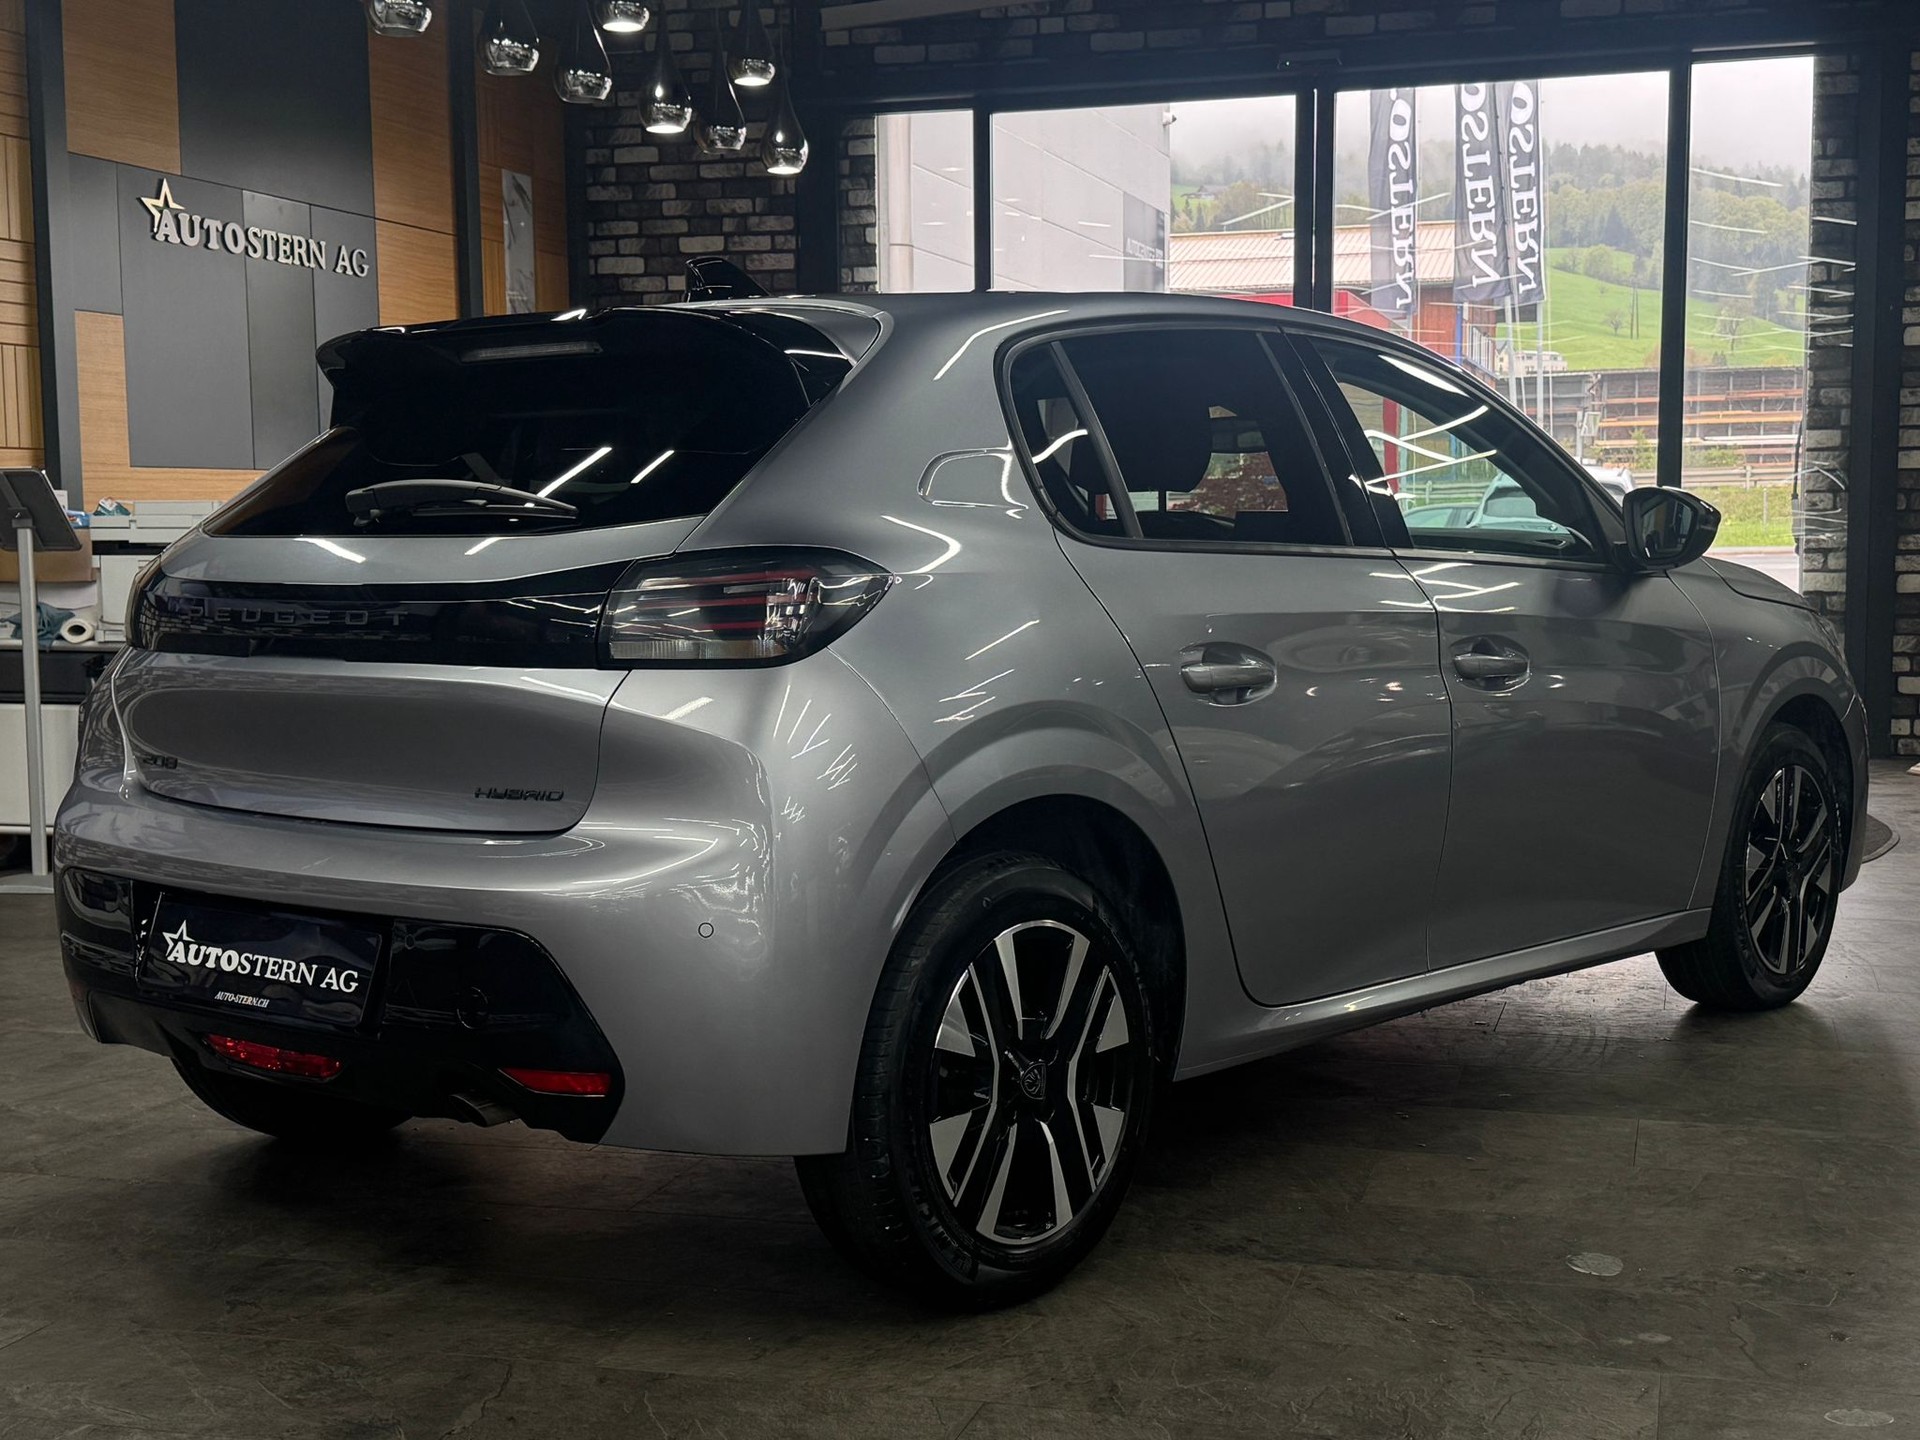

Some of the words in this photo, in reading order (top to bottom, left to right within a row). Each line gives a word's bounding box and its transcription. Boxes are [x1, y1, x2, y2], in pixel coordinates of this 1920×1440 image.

[155, 208, 327, 270] AUTOSTERN
[335, 245, 370, 278] AG
[187, 606, 409, 627] PEUGEOT
[474, 787, 565, 802] HYBRID
[167, 941, 319, 987] AUTOSTERN
[320, 967, 359, 994] AG
[214, 991, 270, 1009] AUTO-STERN.CH
